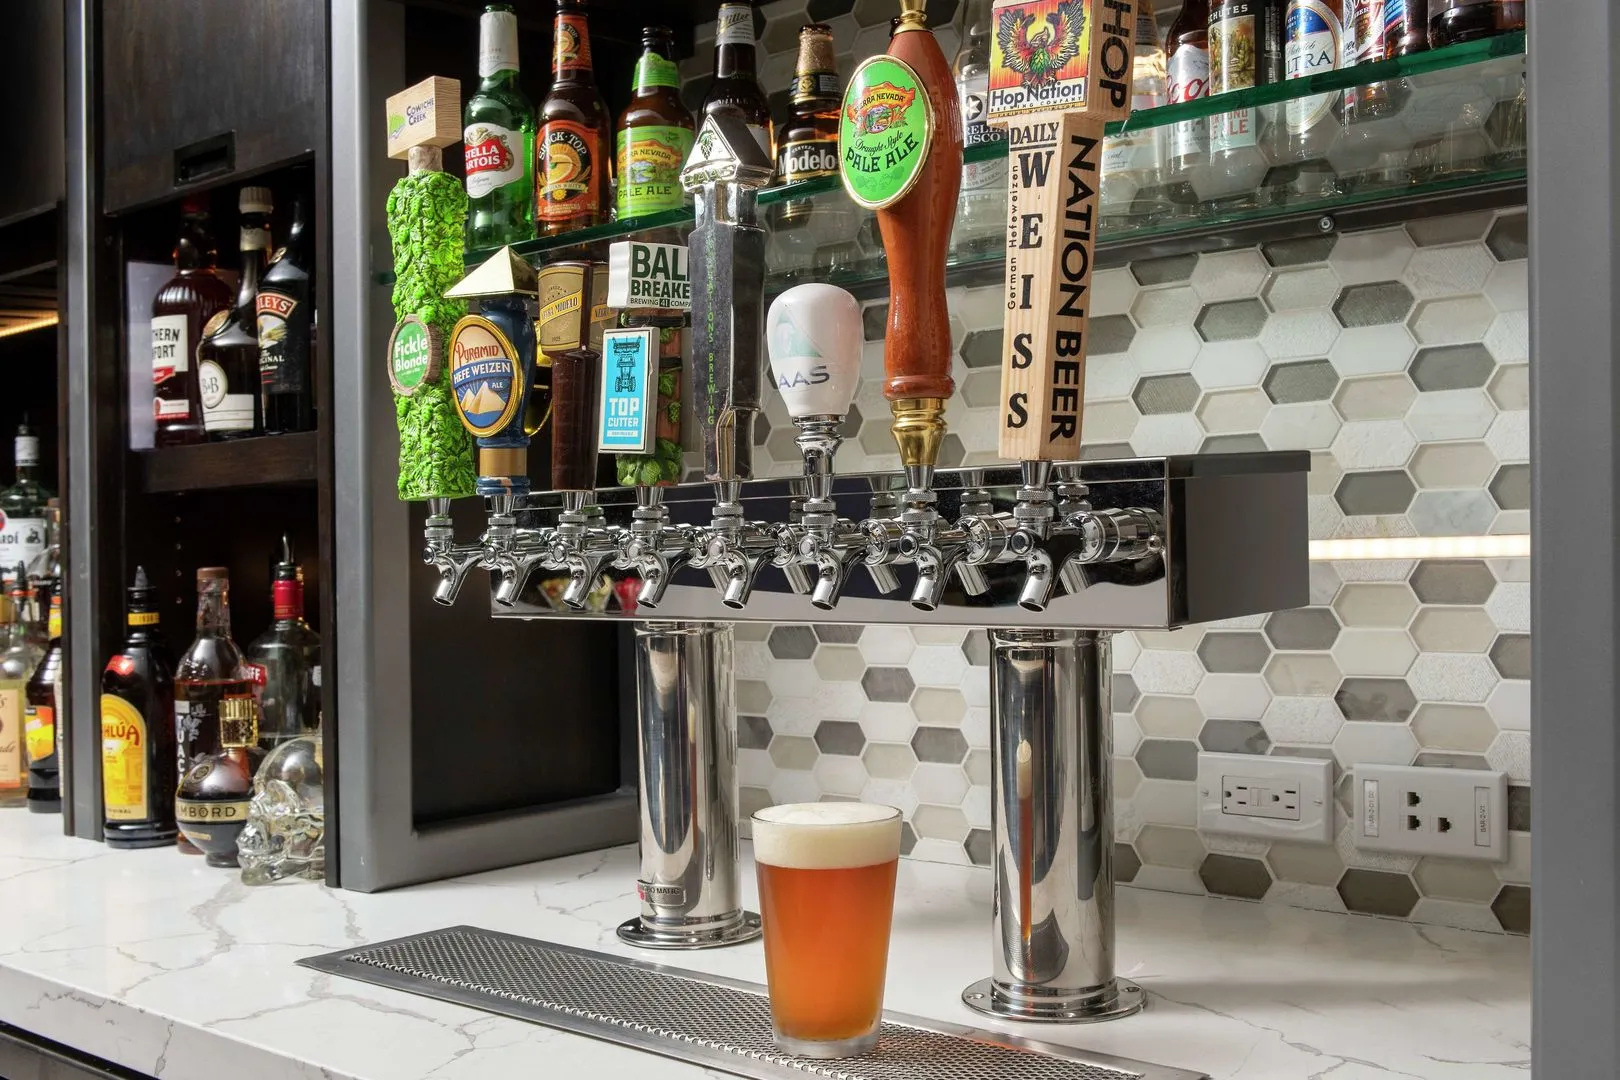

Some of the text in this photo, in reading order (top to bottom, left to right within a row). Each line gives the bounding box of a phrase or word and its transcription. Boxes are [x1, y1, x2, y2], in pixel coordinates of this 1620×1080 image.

[1208, 4, 1248, 23] CHUTES
[1099, 0, 1132, 108] HOP
[1287, 50, 1333, 74] LTRA
[876, 92, 905, 102] NEVADA
[991, 82, 1083, 108] Hop Nation
[991, 97, 1082, 112] BREWING COMPANY
[406, 97, 434, 117] COWICHE
[408, 112, 426, 126] CREEK
[967, 132, 1001, 145] ISCO
[1009, 122, 1060, 145] DAILY
[568, 134, 588, 155] TOP
[640, 148, 672, 160] NEVADA
[846, 132, 920, 173] PALE ALE
[778, 149, 836, 176] Modelo
[646, 185, 672, 195] ALE
[1056, 135, 1099, 317] NATION
[1008, 165, 1019, 310] German Hefeweizen
[630, 279, 690, 299] BREAKE
[630, 297, 659, 306] BREWING
[395, 333, 429, 358] Fickle
[395, 352, 428, 372] Blonde
[453, 362, 511, 385] HEFE WEIZEN
[706, 352, 716, 425] BREWING
[1049, 330, 1082, 443] BEER
[608, 397, 640, 417] TOP
[607, 417, 639, 428] CUTTER
[102, 721, 141, 746] HLÚA
[656, 887, 680, 895] MATIC
